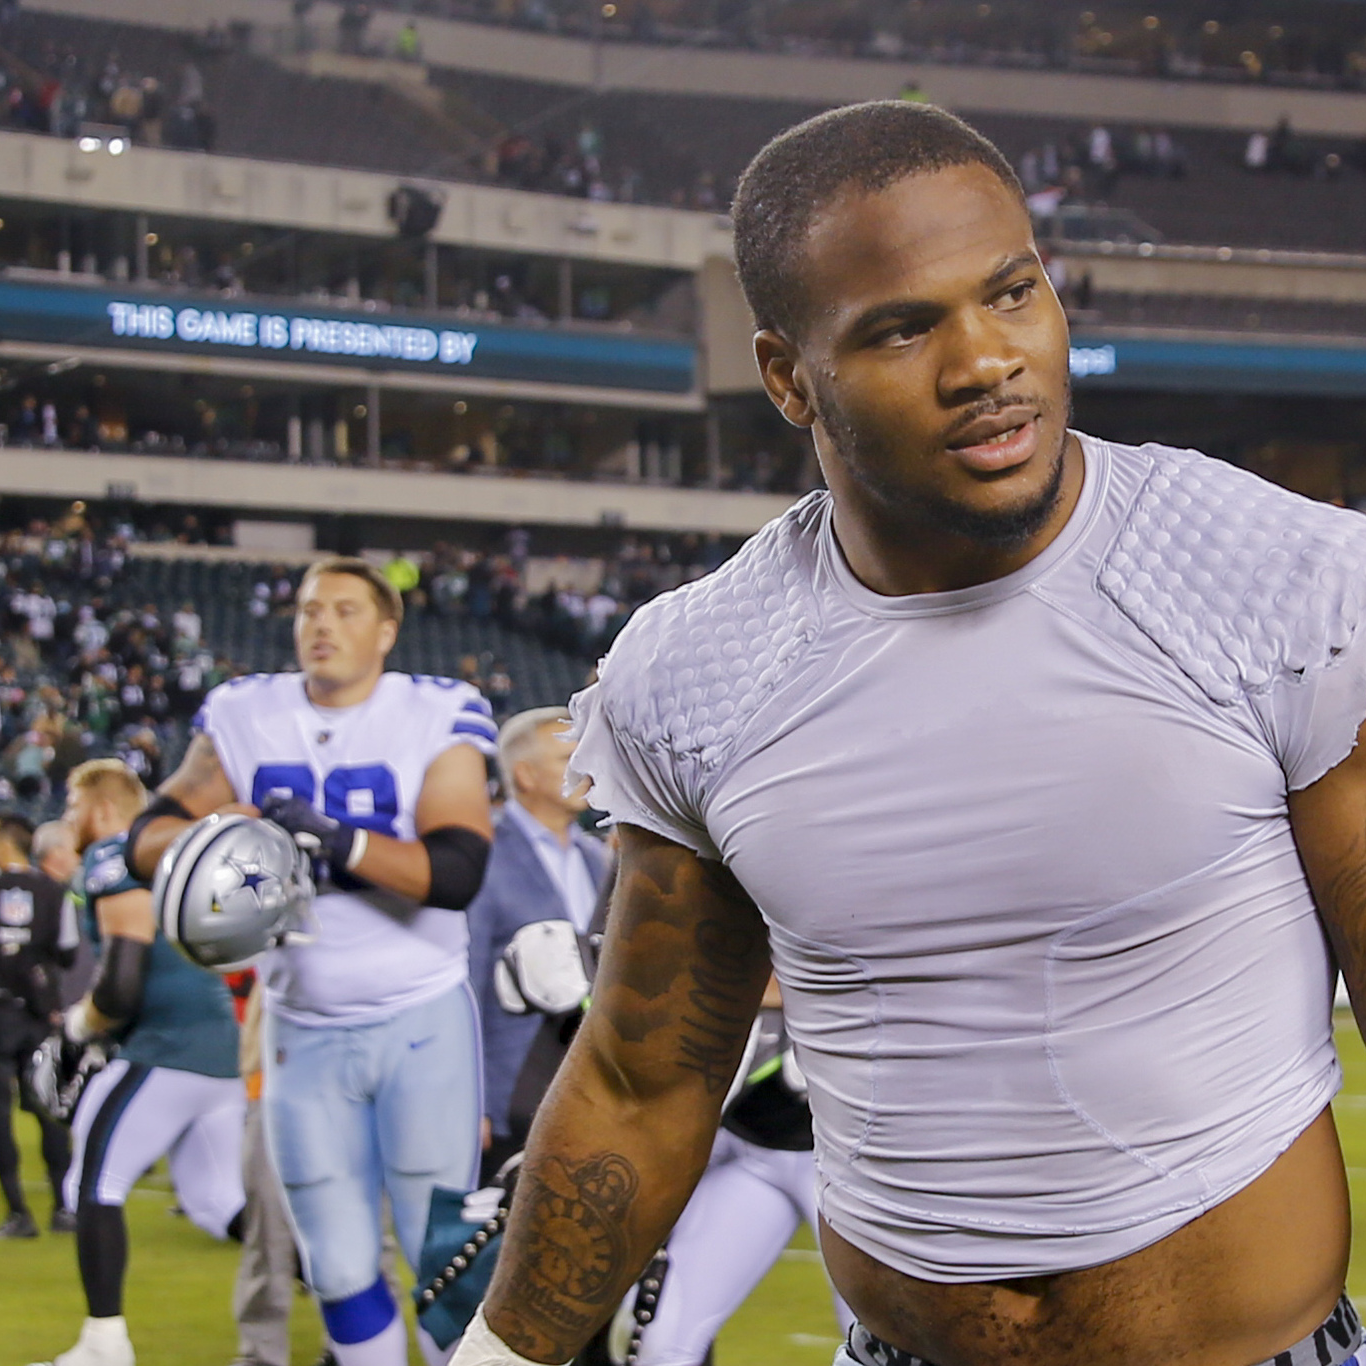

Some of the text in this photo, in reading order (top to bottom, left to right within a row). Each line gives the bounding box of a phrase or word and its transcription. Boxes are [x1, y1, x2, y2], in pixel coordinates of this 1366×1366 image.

[107, 302, 477, 364] THIS GAME IS PRESENTED BY
